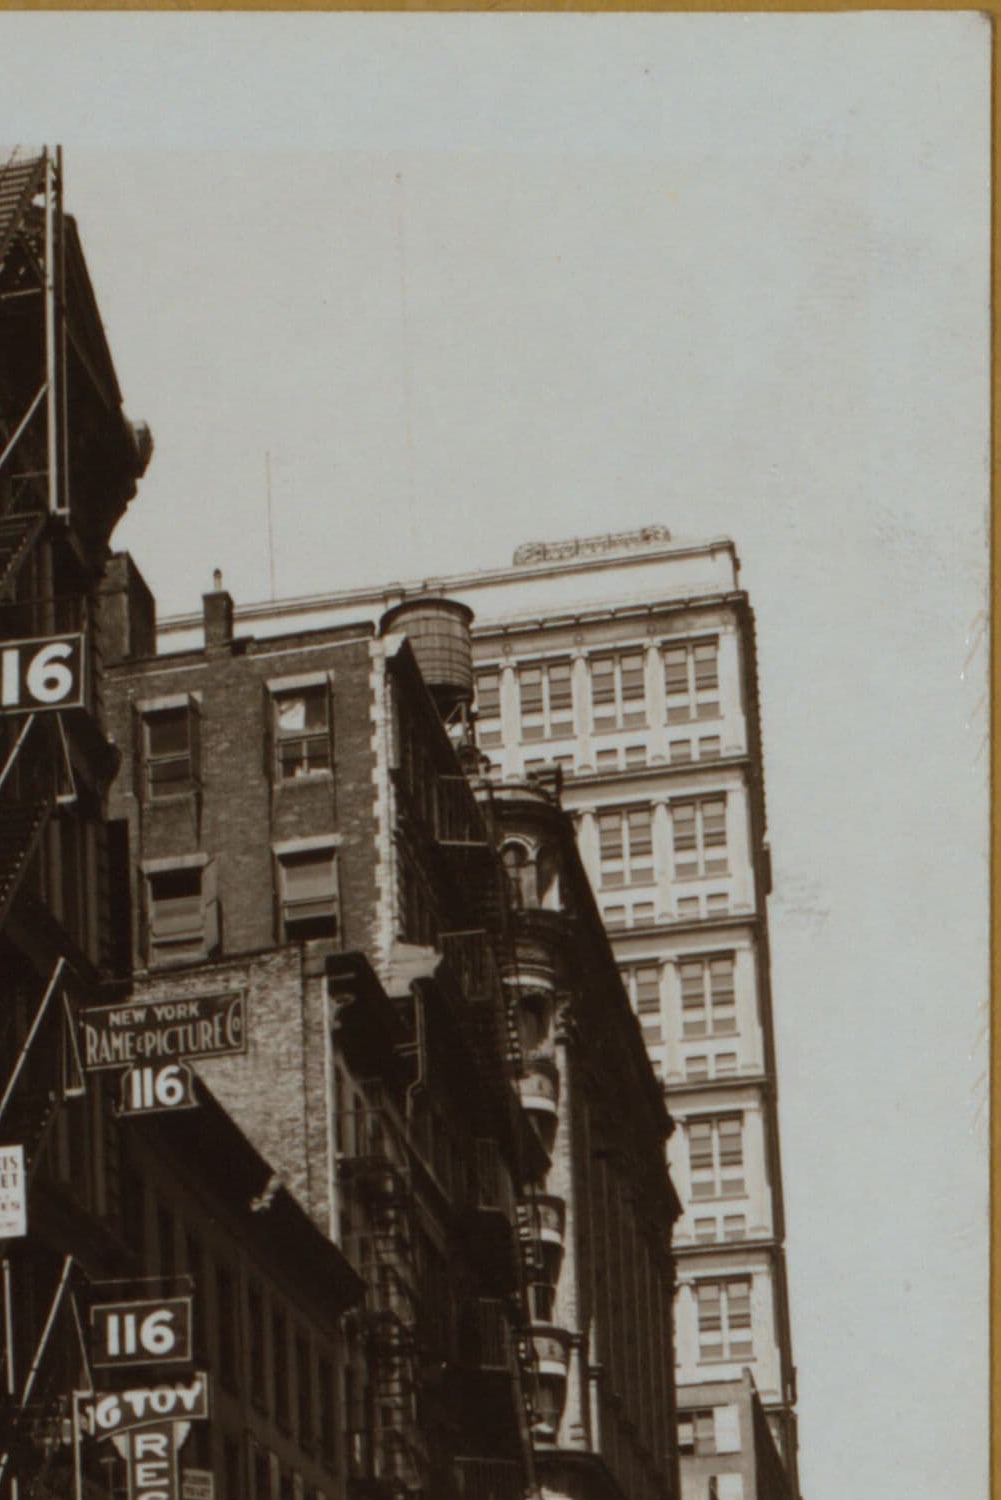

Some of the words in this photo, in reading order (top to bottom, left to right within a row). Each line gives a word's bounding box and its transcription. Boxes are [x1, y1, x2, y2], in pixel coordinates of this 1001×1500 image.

[109, 1007, 148, 1026] NEW
[153, 1001, 200, 1021] YORK
[131, 1064, 184, 1109] 116
[106, 1309, 175, 1356] 116
[122, 1381, 202, 1418] TOY
